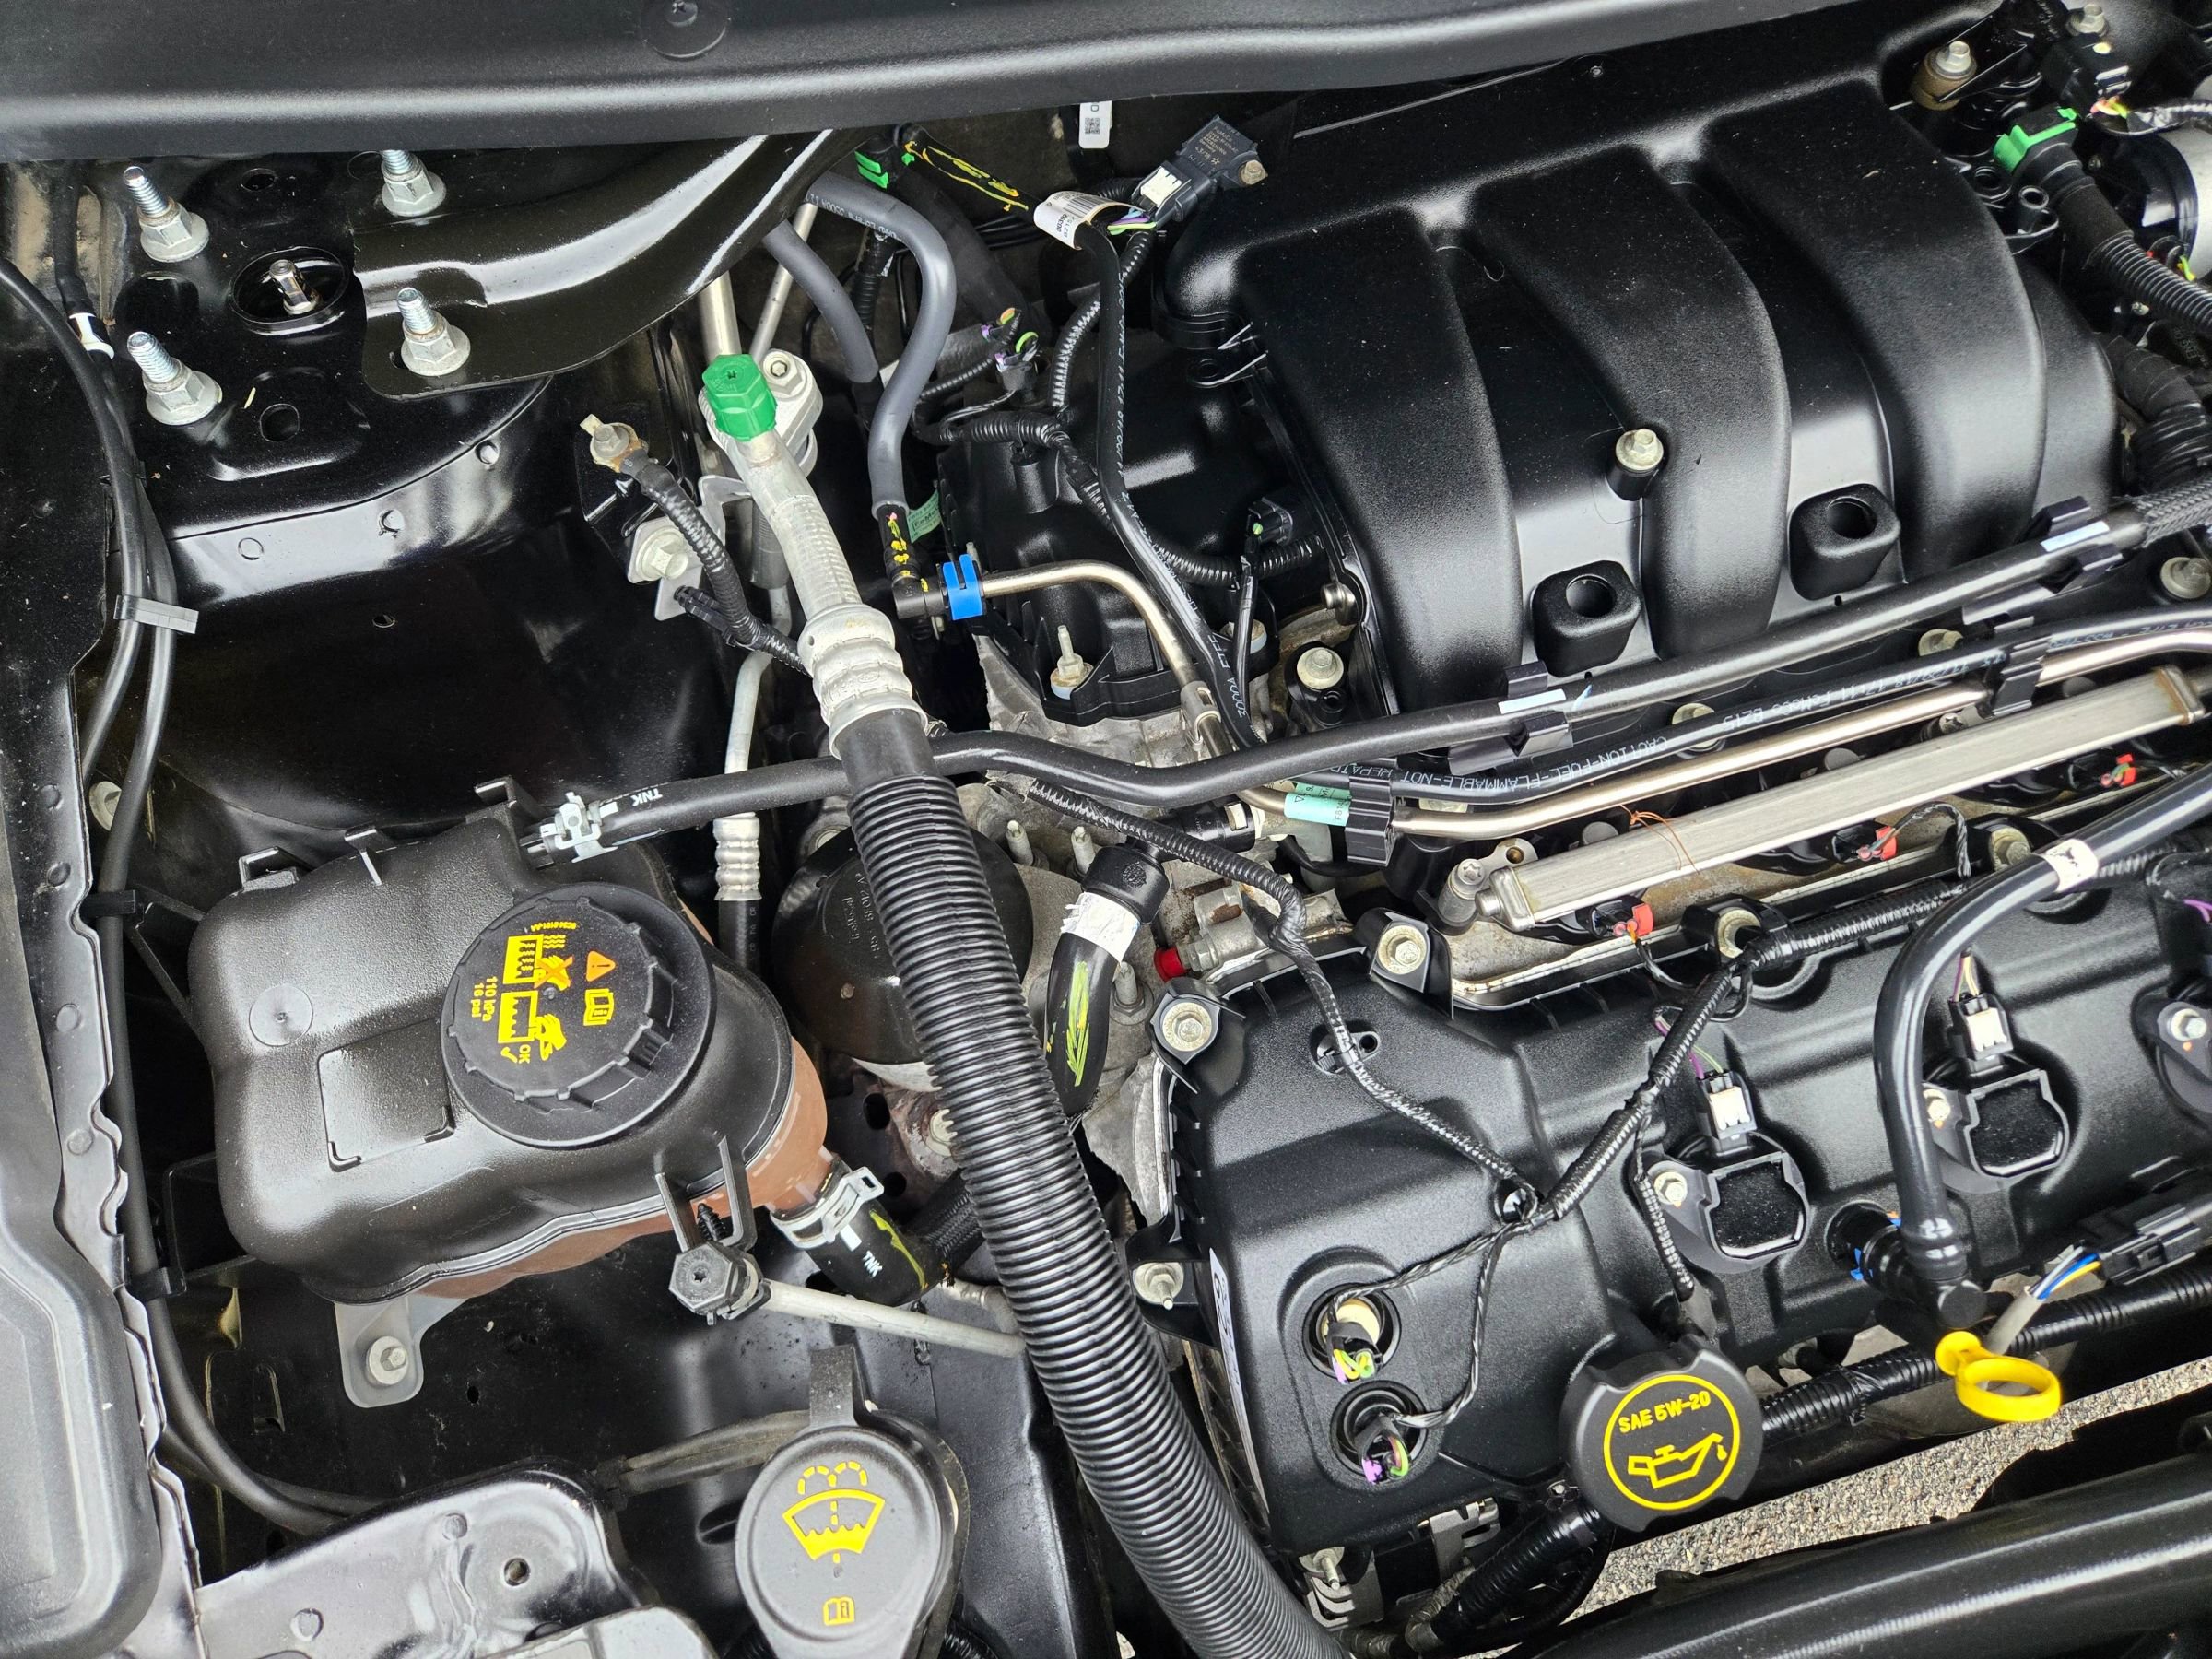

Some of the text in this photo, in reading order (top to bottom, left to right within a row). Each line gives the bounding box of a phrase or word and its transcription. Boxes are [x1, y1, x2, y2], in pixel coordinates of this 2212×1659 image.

[629, 788, 663, 806] TNK
[482, 976, 498, 1022] 110 kPa
[518, 1044, 531, 1064] OK
[862, 1250, 883, 1278] TNK
[1618, 1390, 1712, 1433] SAE 5W-20
